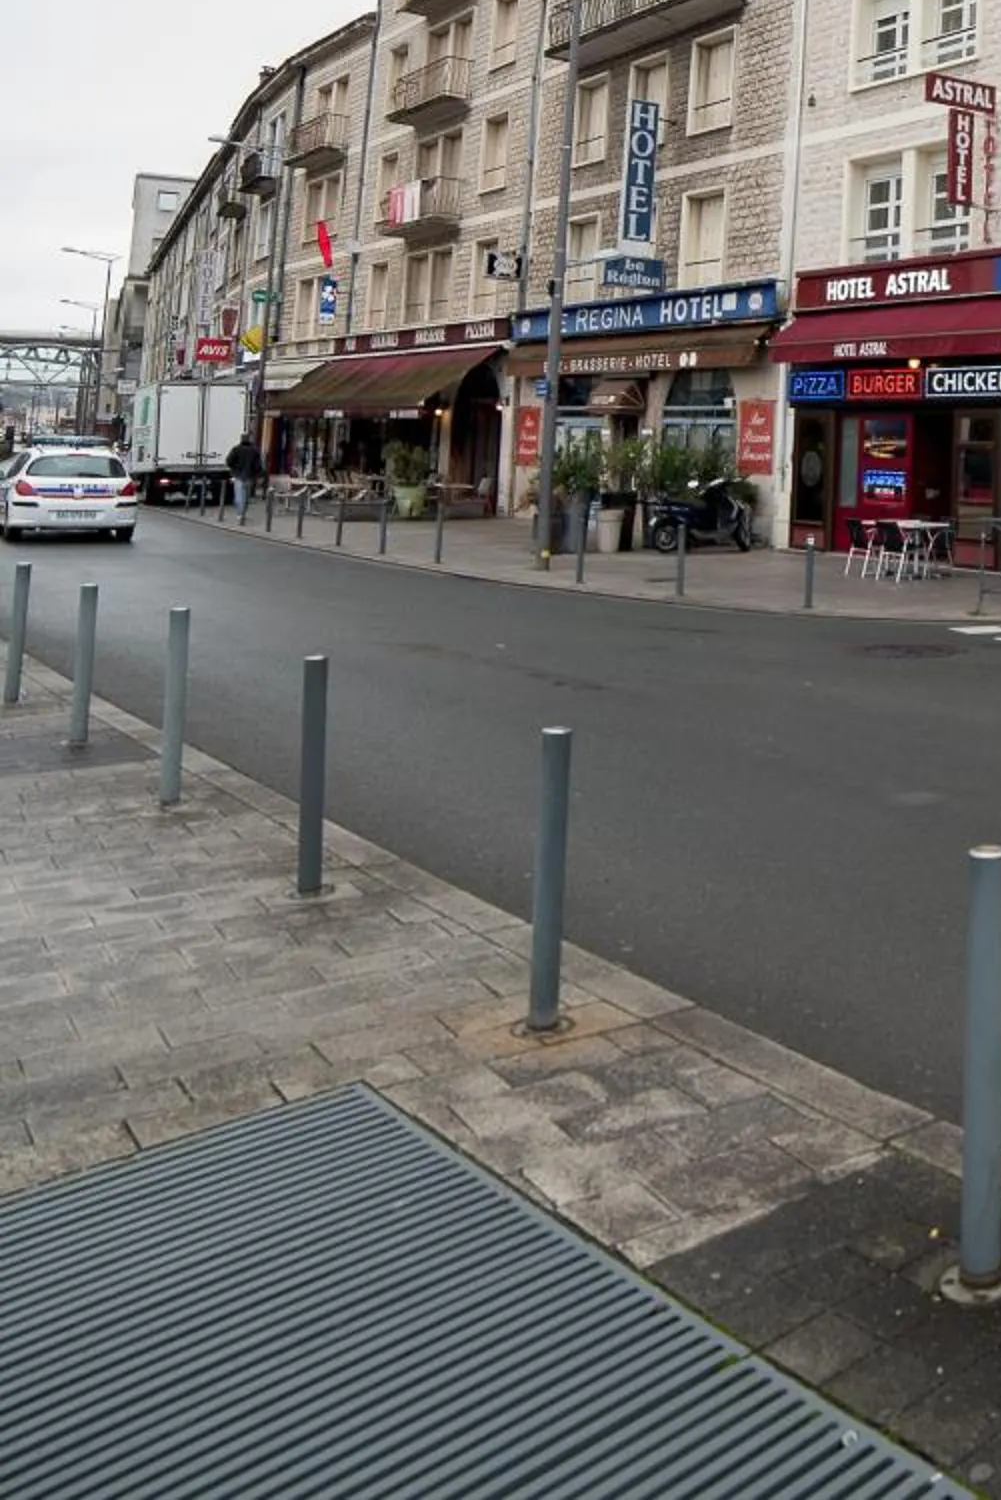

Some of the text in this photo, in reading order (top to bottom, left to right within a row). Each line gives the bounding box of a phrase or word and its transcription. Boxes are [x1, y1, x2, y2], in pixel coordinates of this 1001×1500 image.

[932, 78, 992, 109] ASTRAL
[956, 114, 970, 201] HOTEL
[628, 102, 656, 240] HOTEL
[826, 268, 952, 301] HOTEL ASTRAL
[575, 304, 643, 332] REGINA
[660, 295, 723, 323] HOTEL
[199, 345, 229, 357] AVIS
[834, 342, 888, 357] HOTEL ASTRAL
[570, 355, 627, 373] BRASSERIE
[635, 353, 671, 370] HOTEL
[793, 375, 838, 396] PIZZA
[853, 373, 915, 394] BURGER
